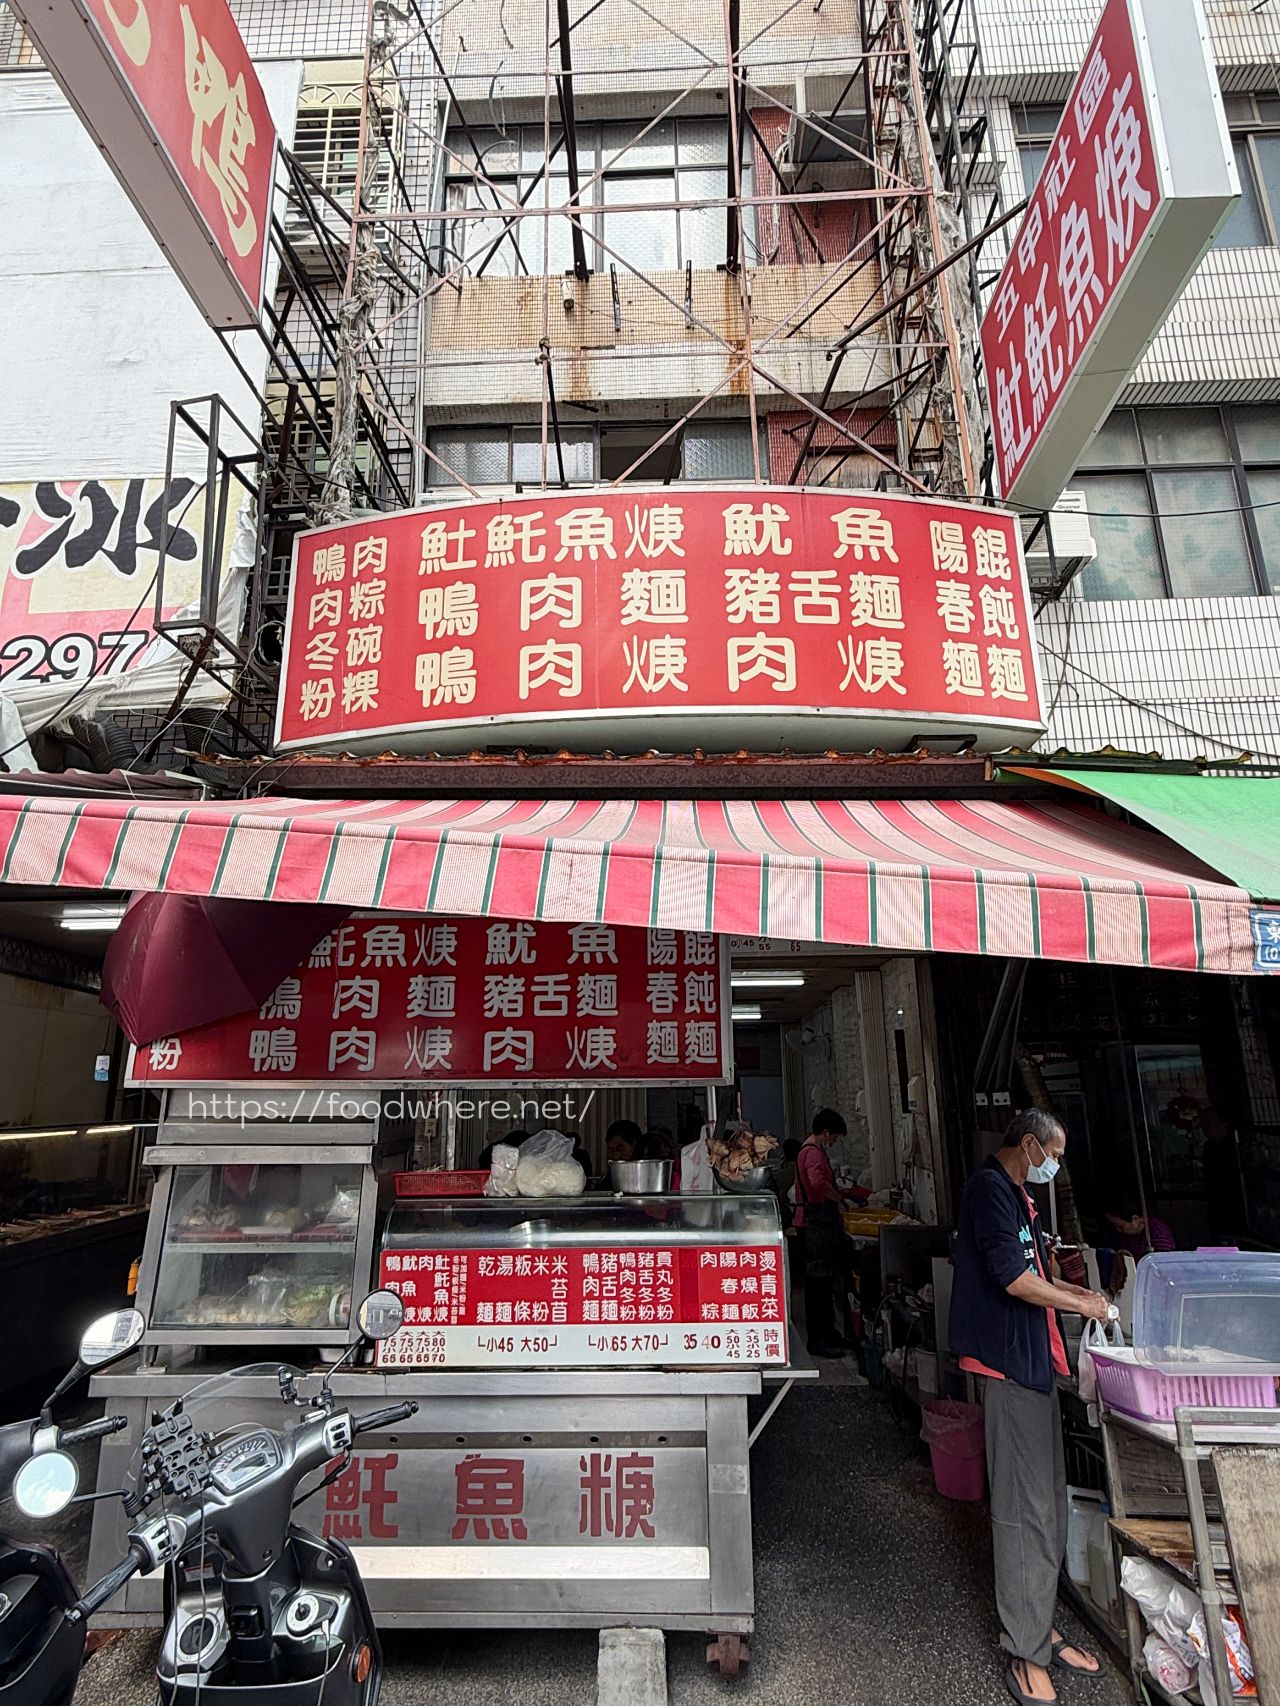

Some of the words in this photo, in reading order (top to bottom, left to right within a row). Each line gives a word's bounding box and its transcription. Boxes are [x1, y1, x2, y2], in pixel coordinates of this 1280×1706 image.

[997, 35, 1110, 343] 五甲社區
[721, 502, 899, 563] 魷魚
[299, 542, 347, 722] 鴨肉冬粉
[341, 535, 388, 714] 肉粽碗粿
[418, 567, 689, 641] 鴨肉麵
[724, 567, 905, 630] 豬舌麵
[929, 520, 985, 697] 陽春麵
[971, 524, 1029, 702] 餛飩麵
[0, 632, 150, 684] 297
[726, 631, 907, 695] 肉焿
[485, 923, 619, 967] 魷魚
[484, 973, 619, 1020] 豬舌麵
[646, 928, 681, 1065] 陽春麵
[683, 930, 718, 1065] 餛飩麵
[482, 1025, 619, 1072] 肉焿
[476, 1255, 495, 1323] 乾麵
[495, 1255, 513, 1323] 湯麵
[532, 1254, 550, 1322] 米粉
[582, 1252, 600, 1322] 鴨肉麵
[601, 1252, 619, 1322] 豬舌麵
[619, 1252, 637, 1321] 鴨肉冬粉
[637, 1251, 655, 1321] 豬舌冬粉
[655, 1251, 675, 1321] 貢丸冬粉
[719, 1251, 740, 1320] 陽春麵
[740, 1251, 760, 1320] 肉燥飯
[759, 1250, 779, 1320] 燙青菜
[683, 1333, 698, 1350] 35
[763, 1328, 781, 1358] 時價
